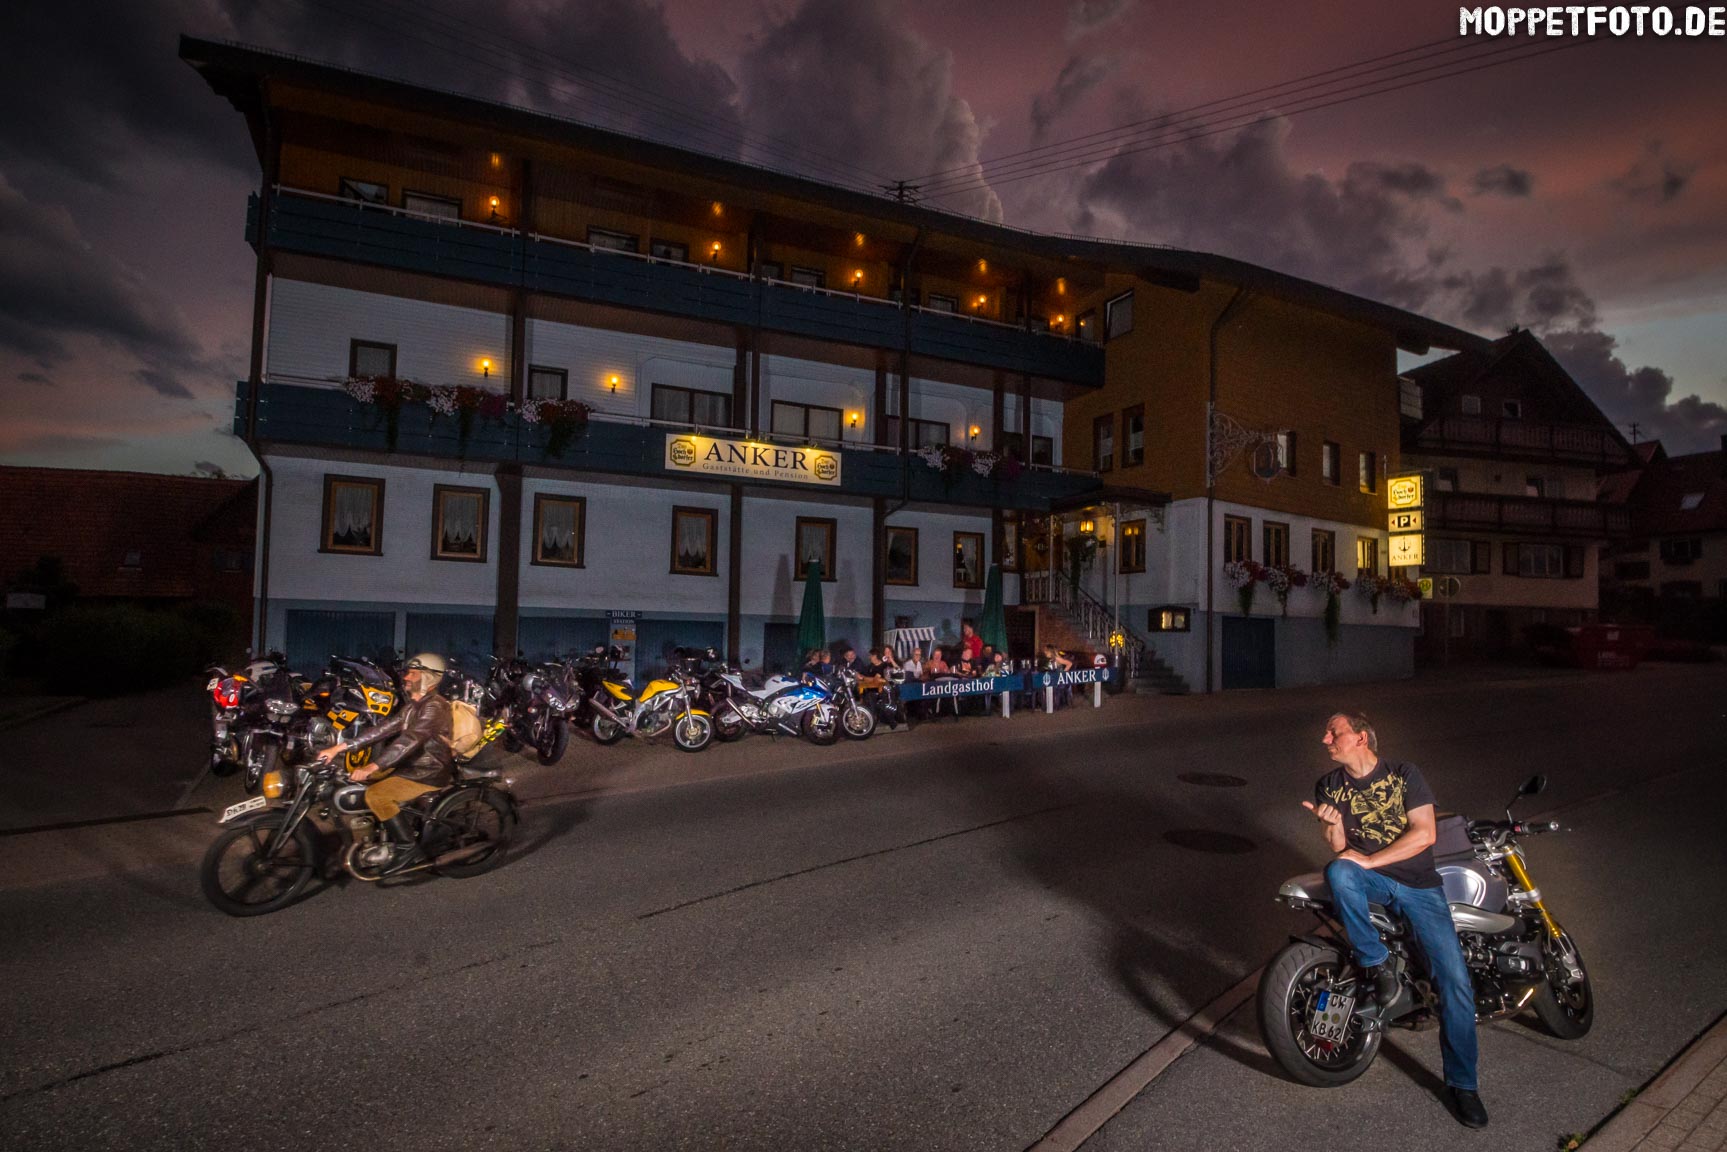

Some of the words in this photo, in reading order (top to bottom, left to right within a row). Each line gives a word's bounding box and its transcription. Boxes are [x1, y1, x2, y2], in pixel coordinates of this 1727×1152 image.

[704, 442, 809, 471] ANKER
[702, 462, 750, 474] Gaststätte
[774, 470, 809, 480] Pension
[1400, 516, 1409, 527] P
[1391, 553, 1419, 561] ANKER
[611, 610, 636, 618] BIKER
[1057, 669, 1097, 686] ANKER
[922, 678, 994, 697] Landgasthof
[1327, 1026, 1342, 1041] 62
